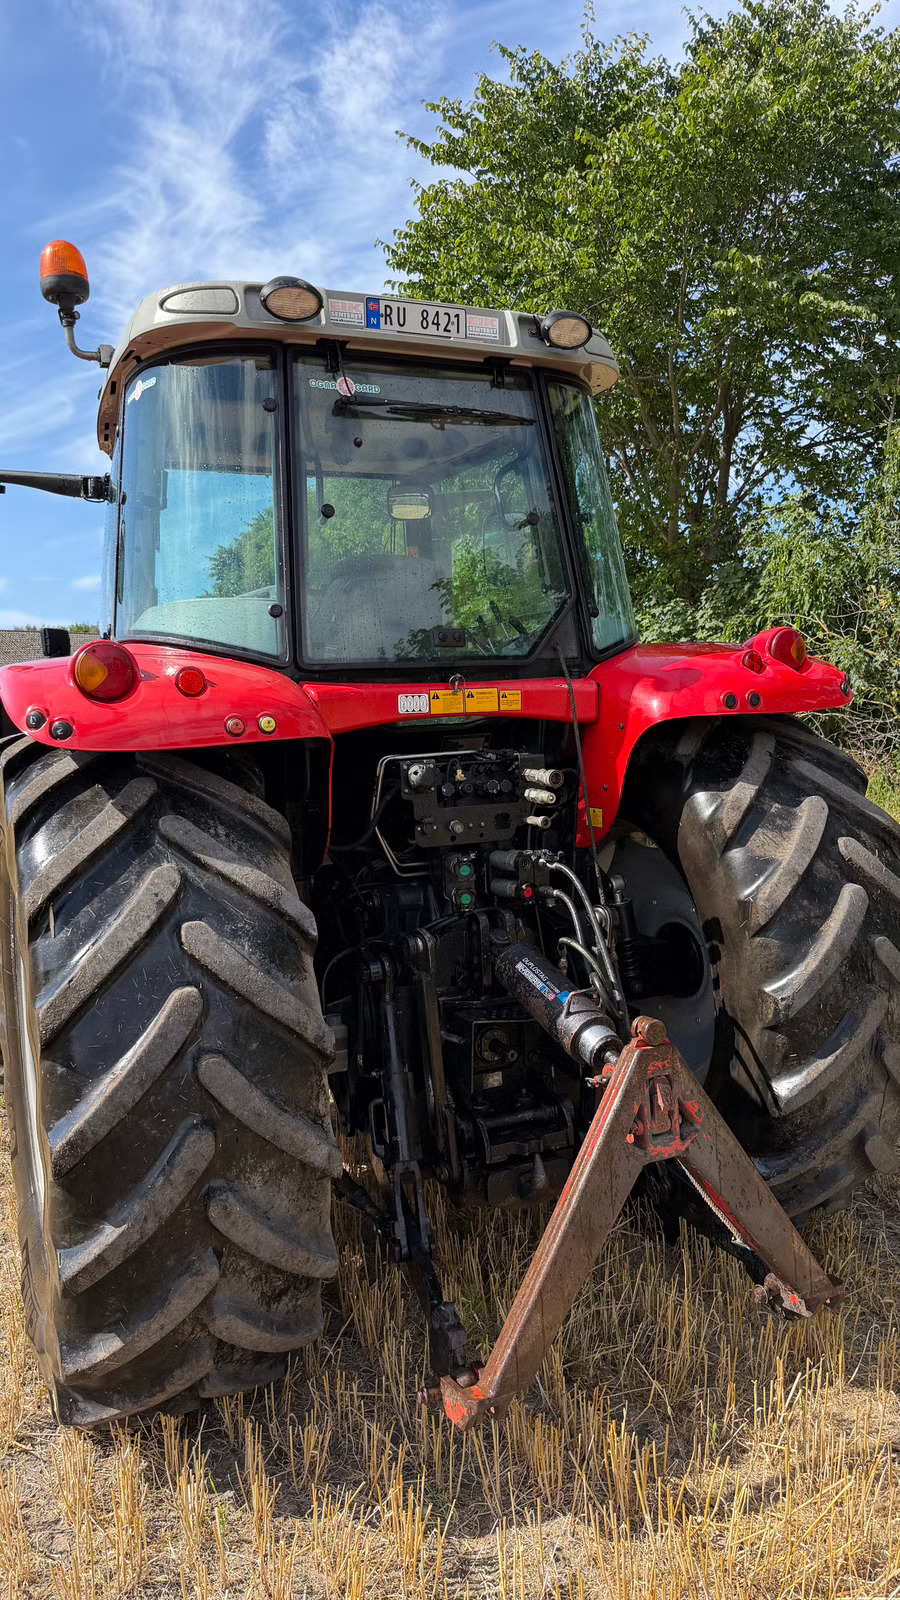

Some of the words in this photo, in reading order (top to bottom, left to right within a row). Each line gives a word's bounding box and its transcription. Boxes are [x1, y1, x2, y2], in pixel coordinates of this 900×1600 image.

[330, 301, 361, 313] EIK
[331, 311, 362, 320] SENTERET
[370, 317, 377, 325] N
[384, 304, 406, 328] RU
[420, 309, 460, 334] 8421
[309, 379, 337, 390] OGNA
[355, 383, 380, 394] GARD
[522, 957, 549, 982] DUPLOSTAG
